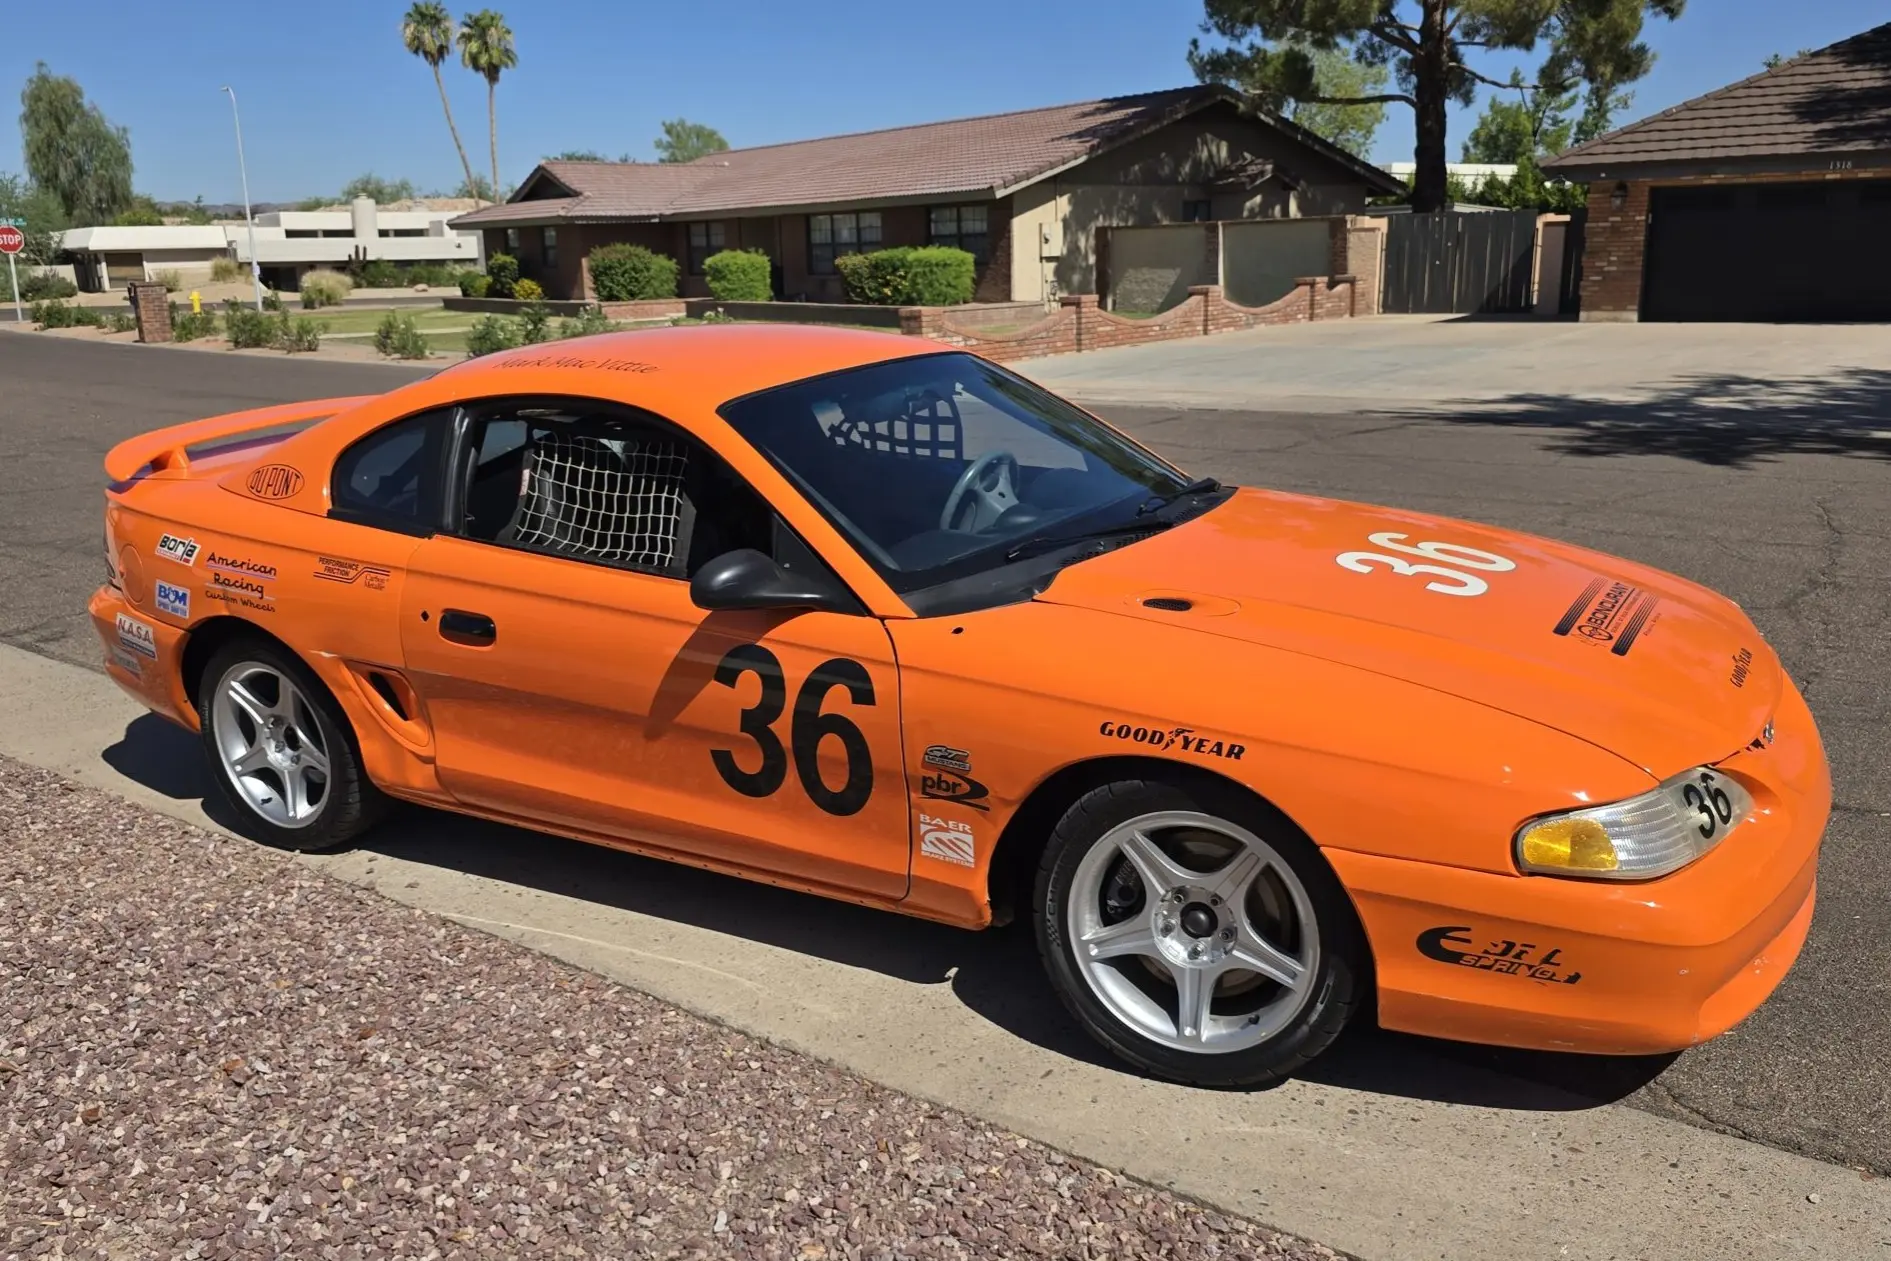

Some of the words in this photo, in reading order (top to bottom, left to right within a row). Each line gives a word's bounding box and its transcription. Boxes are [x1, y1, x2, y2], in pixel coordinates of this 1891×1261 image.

[206, 552, 277, 576] American
[318, 556, 359, 572] PERFORMANCE
[323, 565, 350, 577] FRICTION
[1335, 531, 1516, 597] 36
[213, 572, 264, 600] Racing
[205, 590, 238, 604] Custom
[240, 597, 276, 613] Wheels
[1586, 582, 1629, 626] BONDURANT
[709, 643, 876, 817] 36
[926, 756, 970, 770] MUSTANG
[921, 773, 962, 795] pbr
[1683, 772, 1732, 840] 36
[919, 813, 973, 834] BAER
